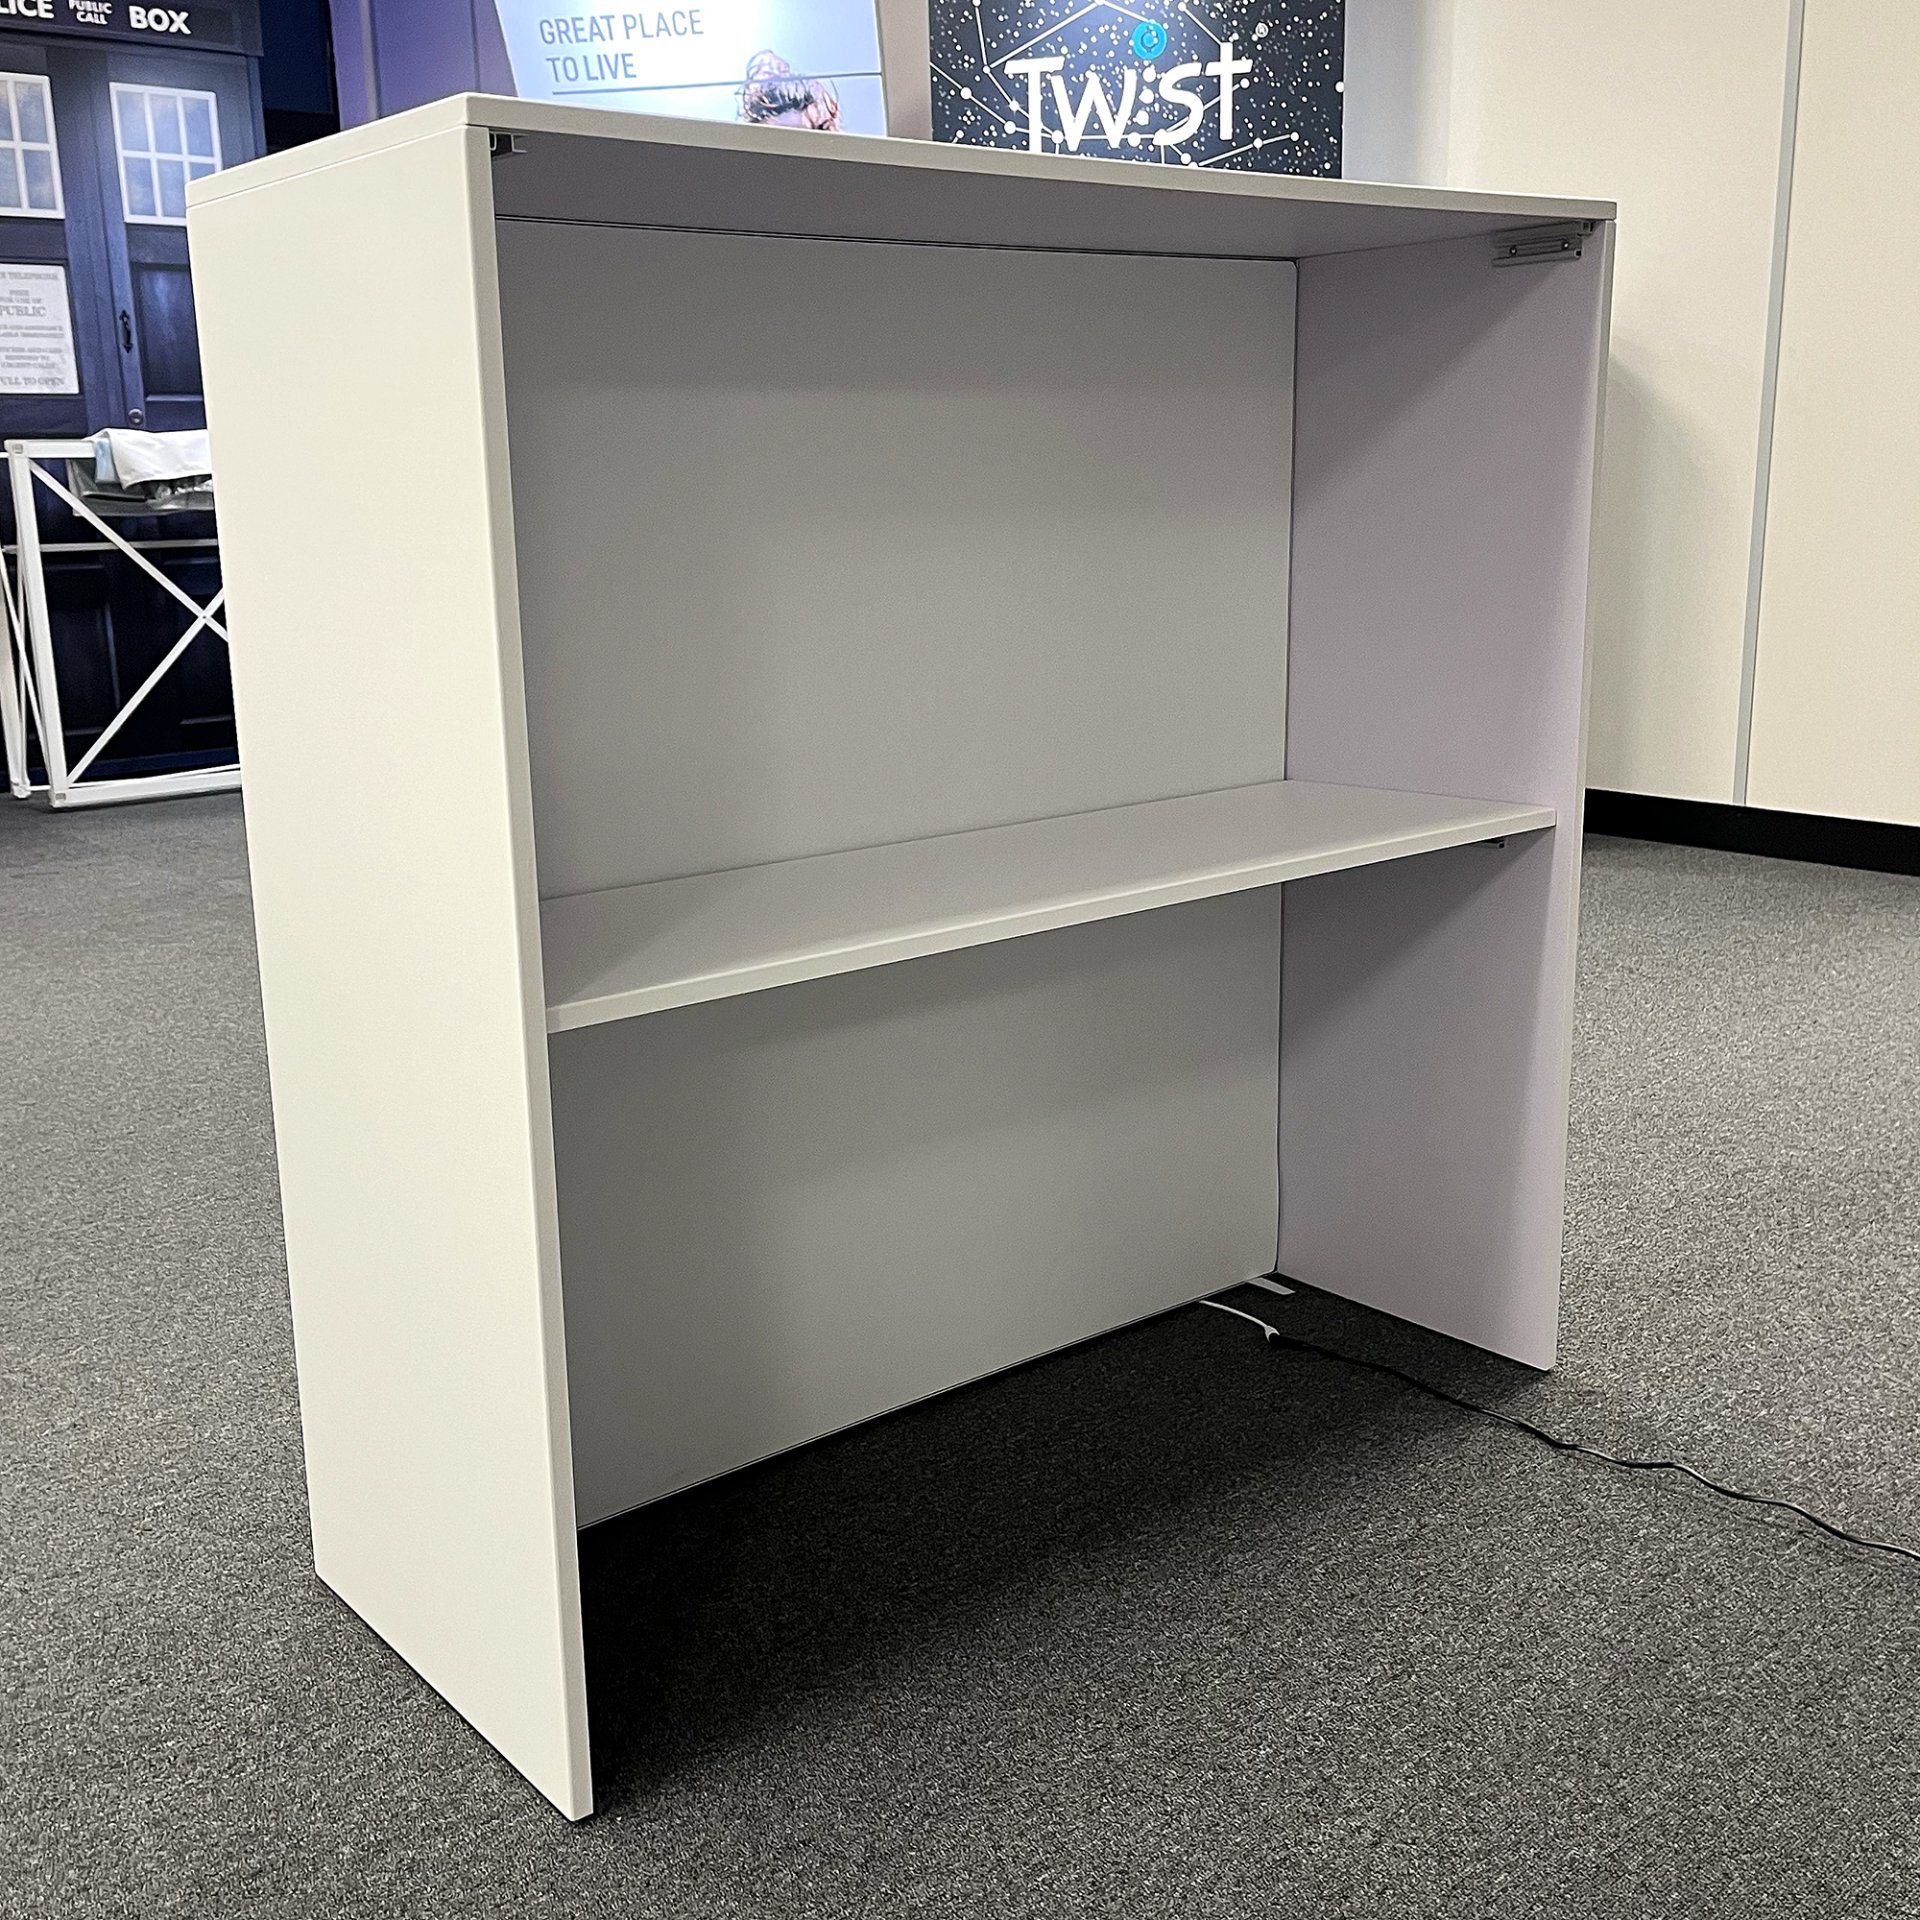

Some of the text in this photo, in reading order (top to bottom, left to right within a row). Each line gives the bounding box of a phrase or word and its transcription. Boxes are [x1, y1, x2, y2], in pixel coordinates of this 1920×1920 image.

[68, 0, 112, 14] PUBLIC
[76, 11, 108, 25] CALL
[128, 5, 192, 34] BOX
[539, 9, 704, 45] GREAT PLACE
[546, 53, 637, 83] TO LIVE
